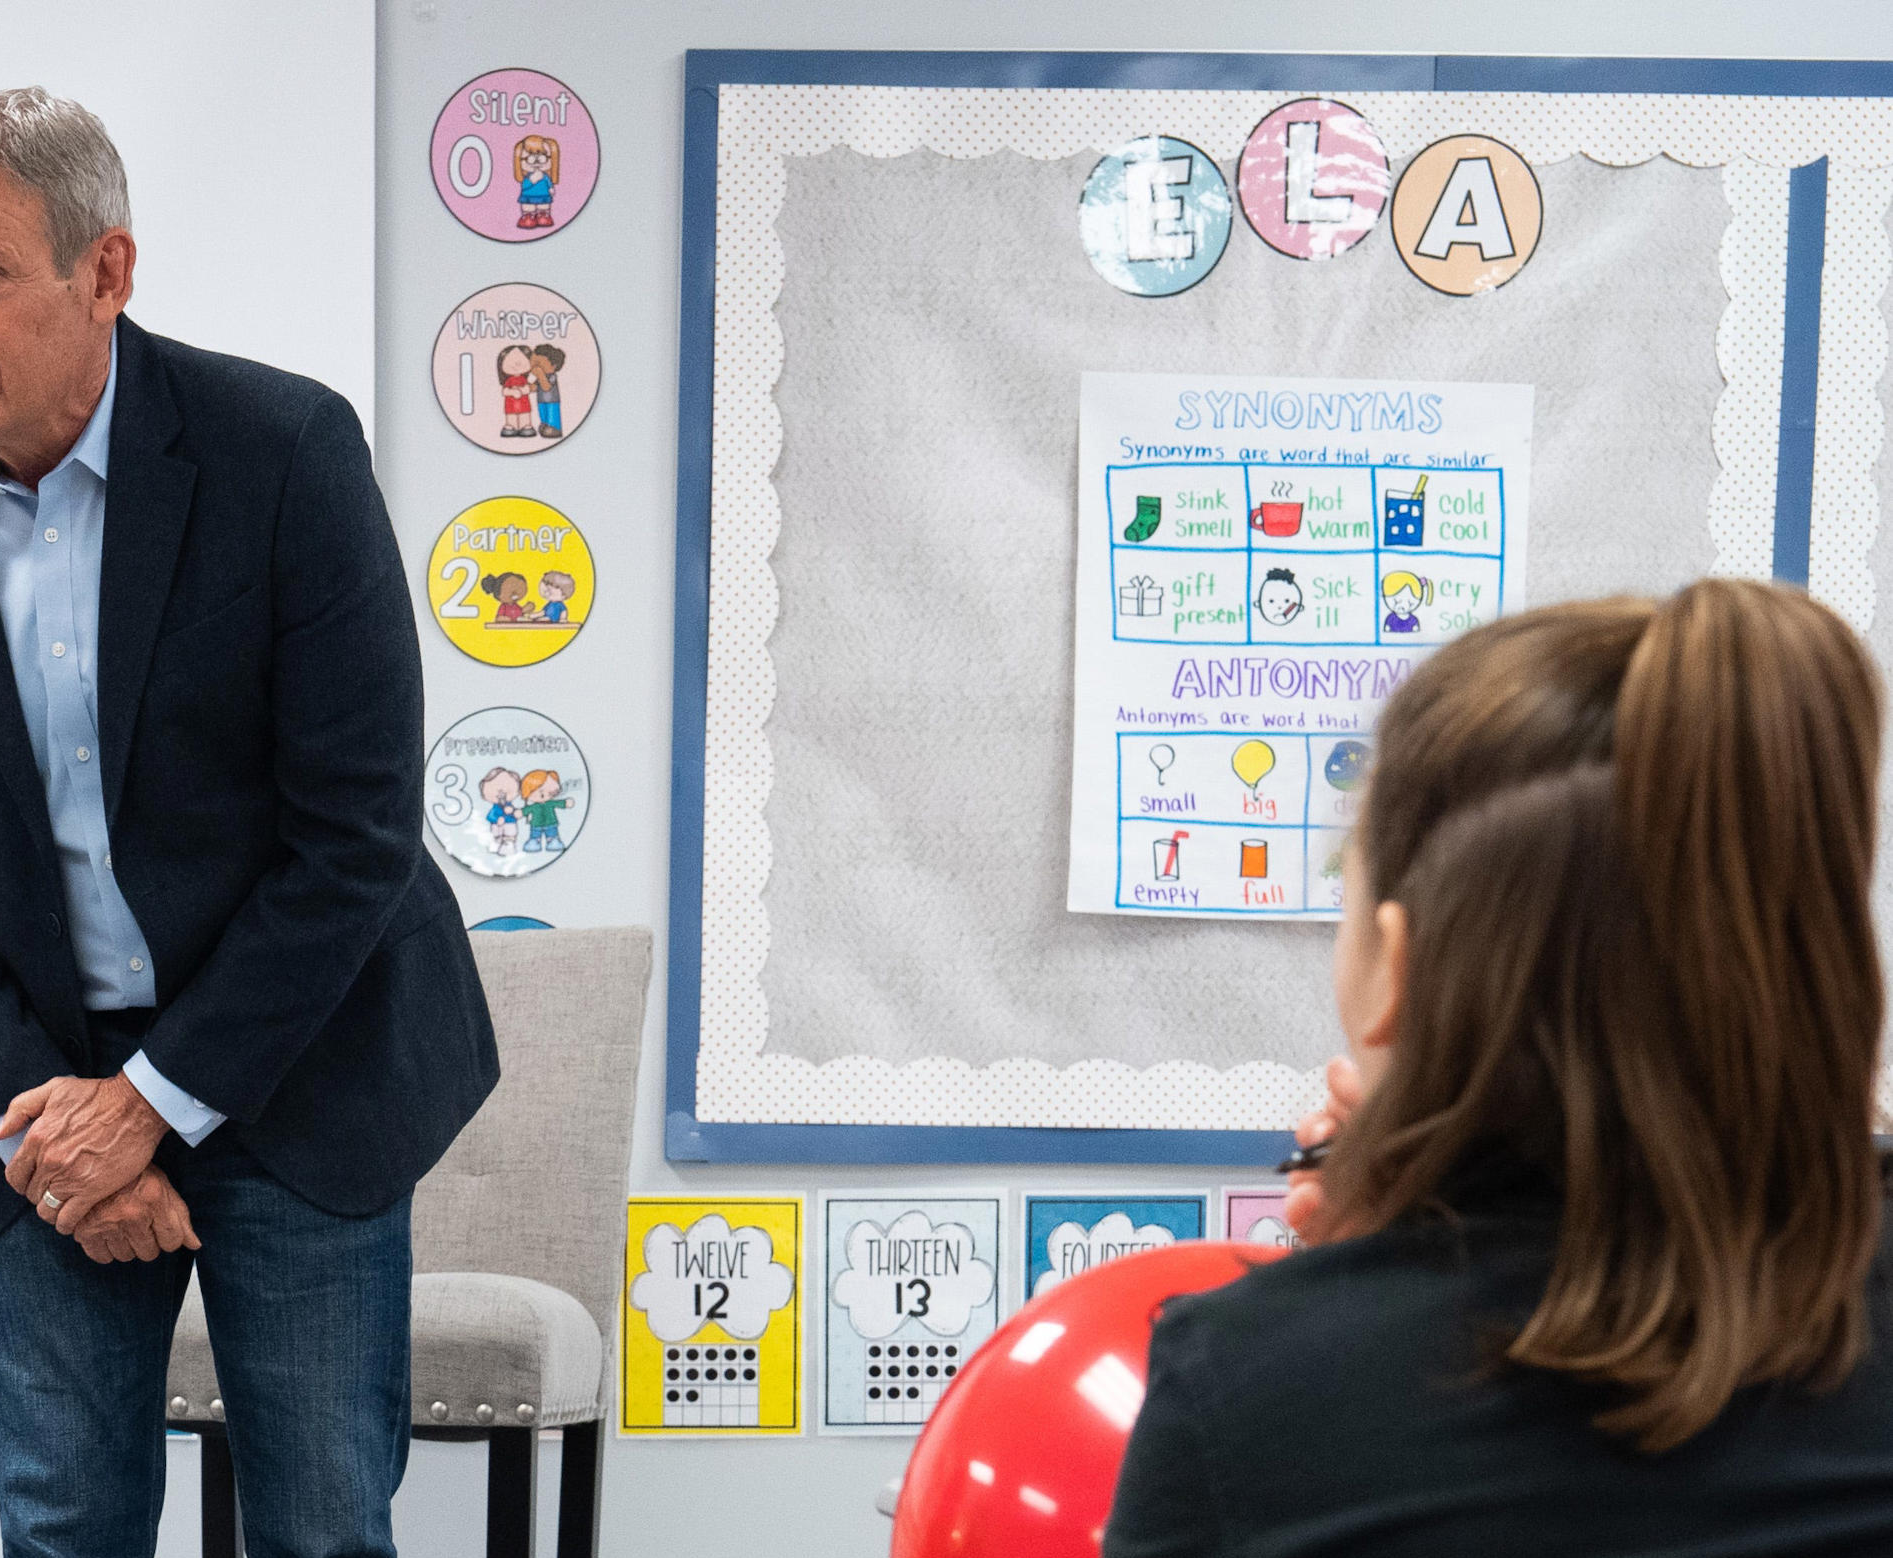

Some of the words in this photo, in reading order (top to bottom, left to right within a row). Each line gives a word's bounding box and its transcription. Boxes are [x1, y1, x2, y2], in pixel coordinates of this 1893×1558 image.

[469, 89, 571, 126] Silent
[456, 310, 577, 341] Whisper
[1175, 390, 1443, 434] SYNONYMS
[1119, 436, 1225, 461] Synonyms
[1239, 448, 1270, 461] are
[1279, 445, 1328, 463] word
[1336, 445, 1371, 464] that
[1383, 453, 1411, 465] are
[1426, 451, 1494, 467] similar
[1308, 486, 1343, 511] hot
[454, 523, 572, 553] Partner
[1307, 520, 1370, 540] warm
[439, 556, 480, 619] 2
[1172, 572, 1215, 607] gift
[1173, 604, 1244, 634] present
[1315, 605, 1338, 629] ill
[1171, 657, 1412, 700] ANTONYM
[1116, 706, 1208, 728] Antonyms
[1220, 711, 1250, 727] are
[1262, 710, 1306, 728] word
[1318, 711, 1358, 729] that
[432, 763, 474, 826] 3
[1140, 792, 1196, 813] small
[1243, 792, 1277, 820] big
[1134, 883, 1199, 906] empty
[1242, 880, 1285, 905] full
[670, 1239, 750, 1280] TWELVE
[865, 1237, 961, 1277] THIRTEEN
[693, 1281, 730, 1319] 12
[895, 1279, 931, 1318] 13
